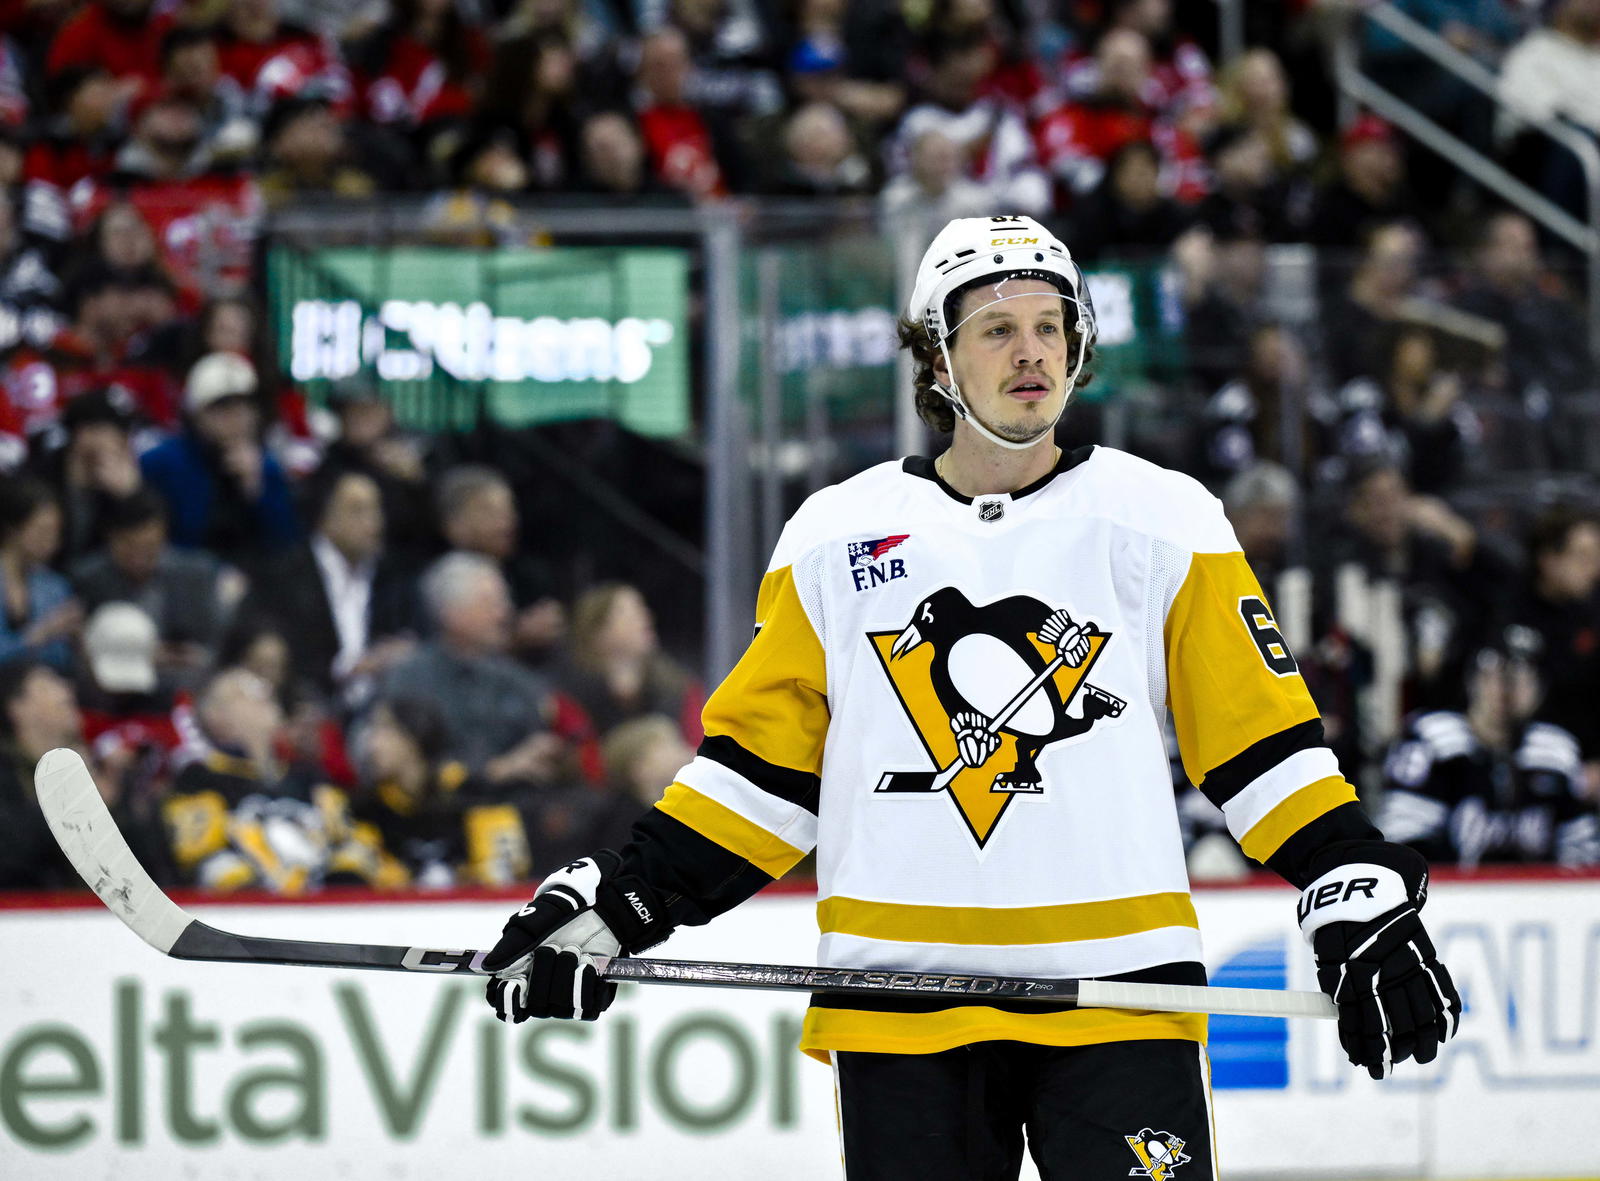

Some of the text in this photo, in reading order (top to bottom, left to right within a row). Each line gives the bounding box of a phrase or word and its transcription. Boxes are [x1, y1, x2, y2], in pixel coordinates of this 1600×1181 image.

[990, 237, 1039, 247] CCM
[851, 559, 908, 592] F.N.B.
[624, 891, 654, 925] MACH
